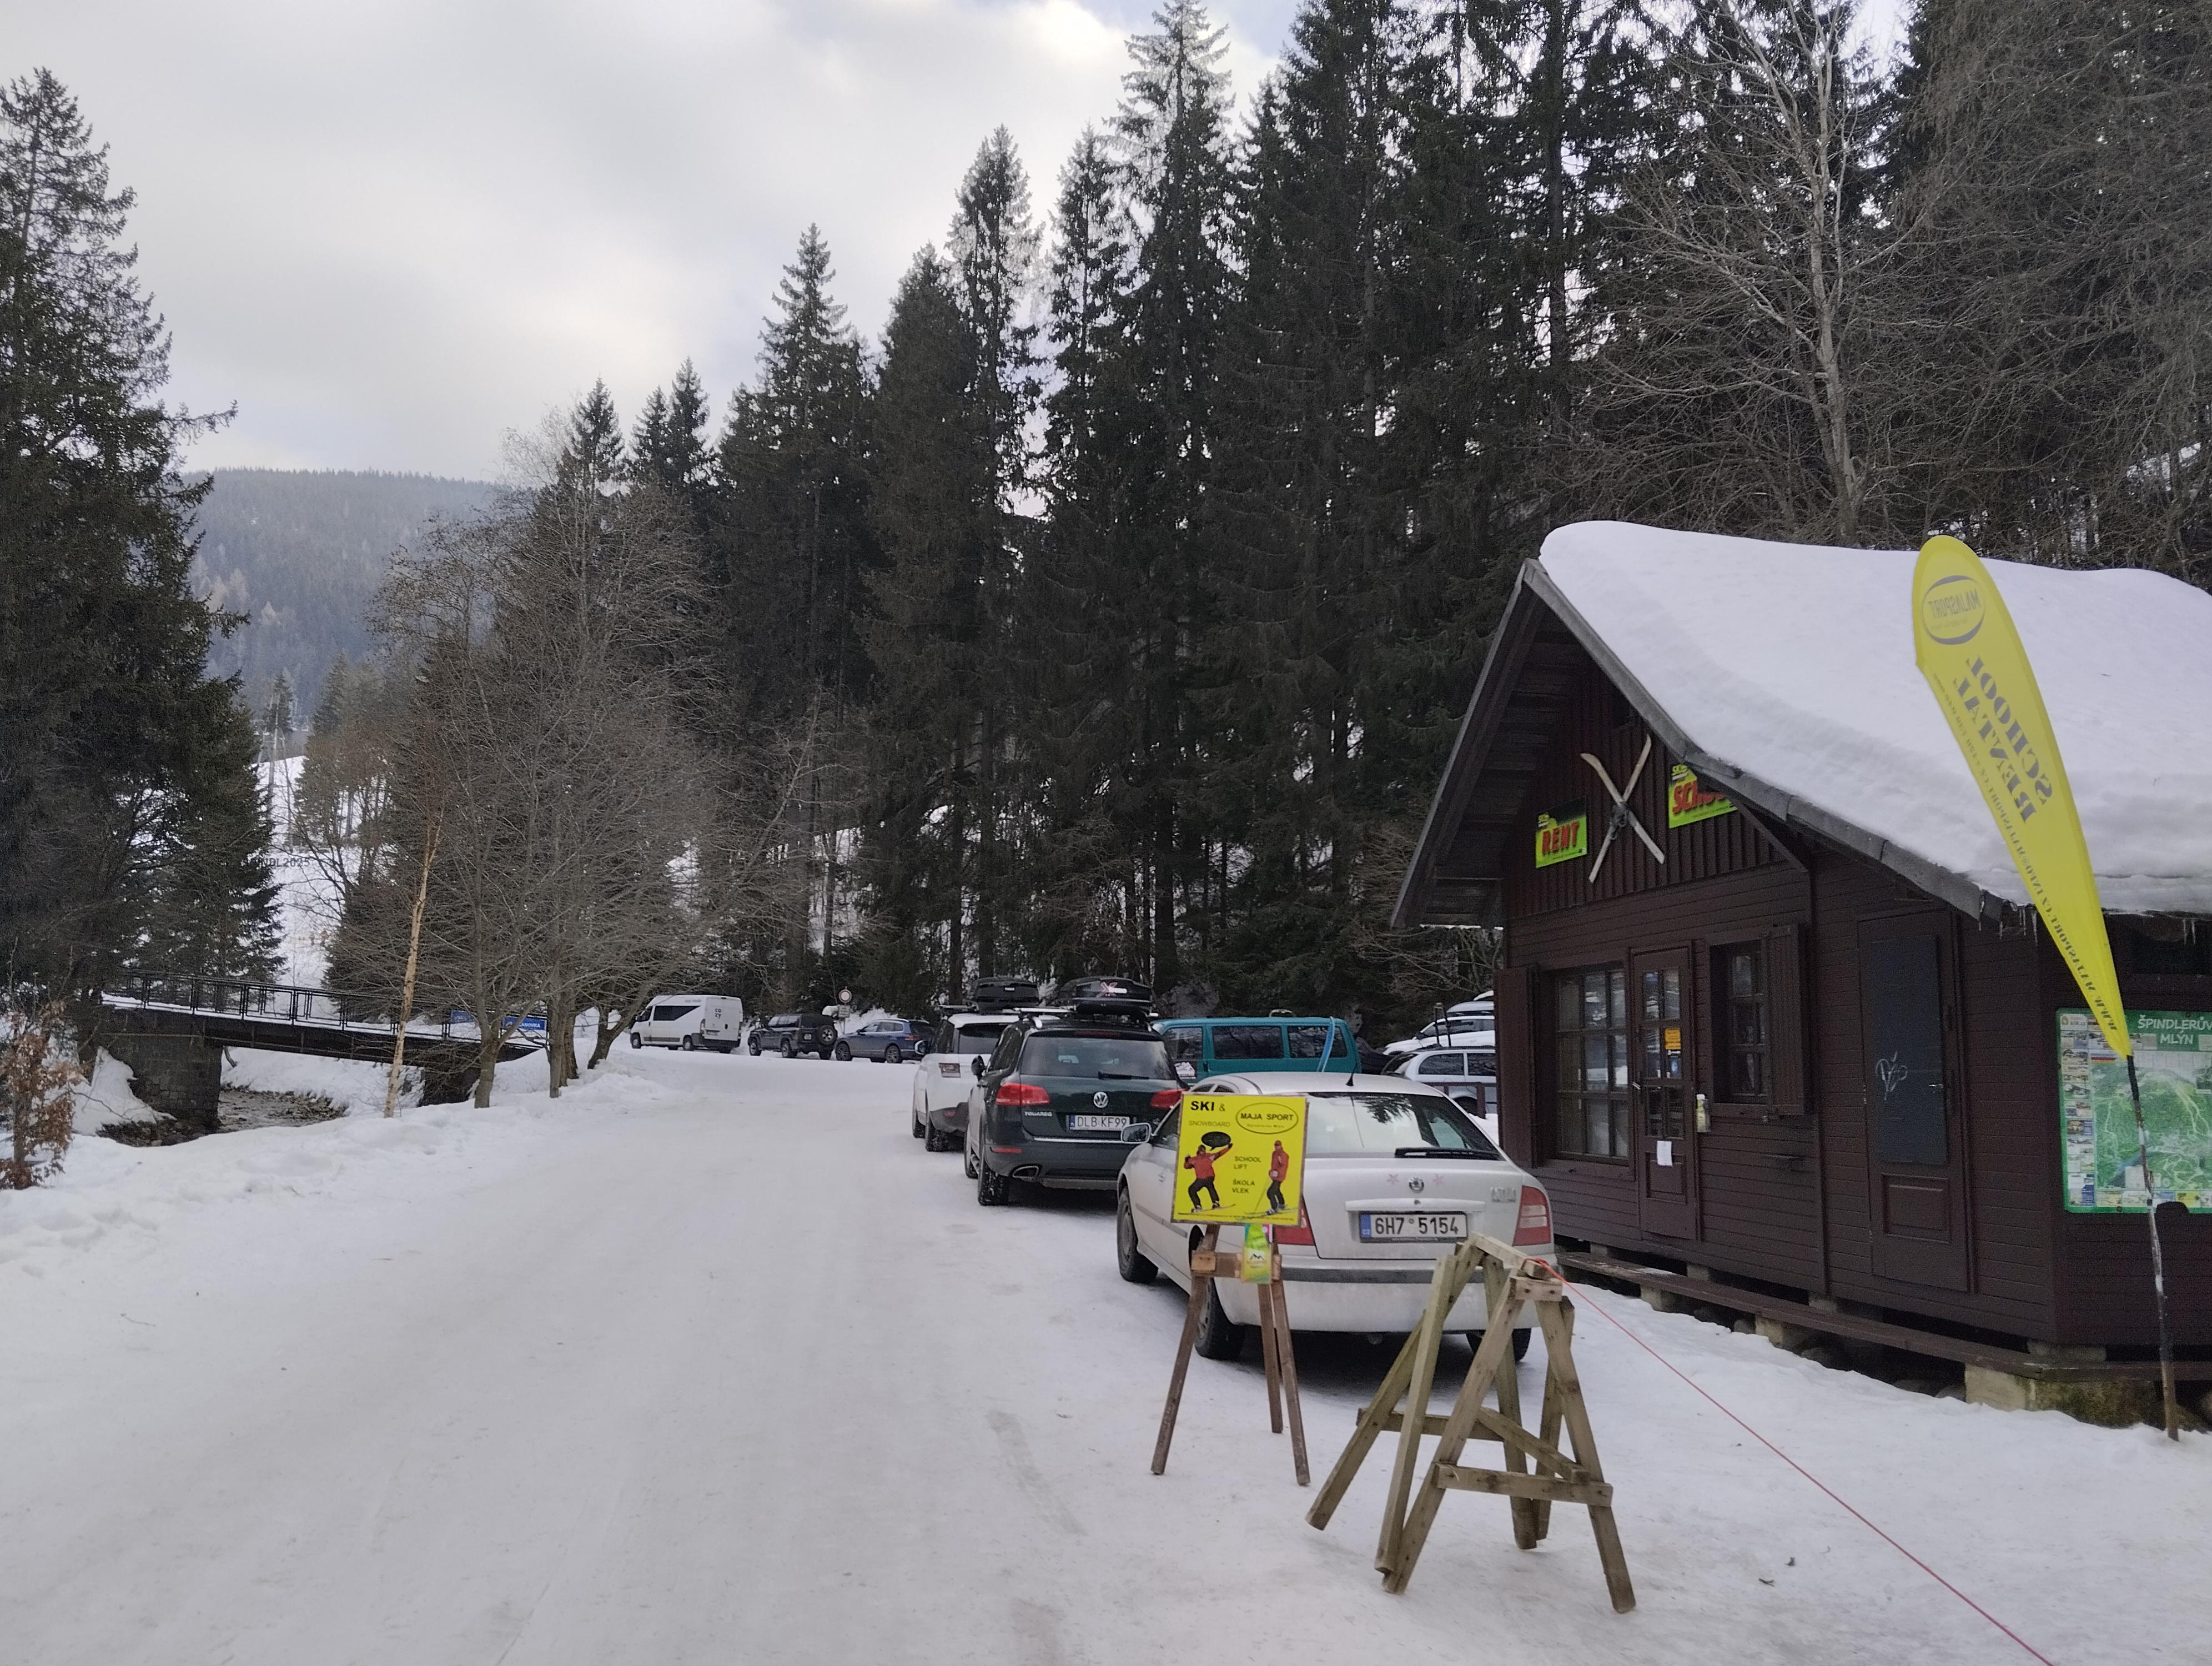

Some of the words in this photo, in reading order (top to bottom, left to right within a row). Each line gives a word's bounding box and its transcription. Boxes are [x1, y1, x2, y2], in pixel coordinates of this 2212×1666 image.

[1541, 820, 1578, 854] RENT
[2160, 1030, 2194, 1044] MLÝN
[1190, 1101, 1215, 1112] SKI
[1218, 1103, 1226, 1112] &
[1077, 1116, 1098, 1127] DLB
[1101, 1117, 1128, 1128] KF99
[1266, 1113, 1294, 1121] SPORT
[1232, 1178, 1255, 1186] ŠKOLA
[1375, 1216, 1404, 1235] 6H7
[1418, 1216, 1459, 1235] 5154
